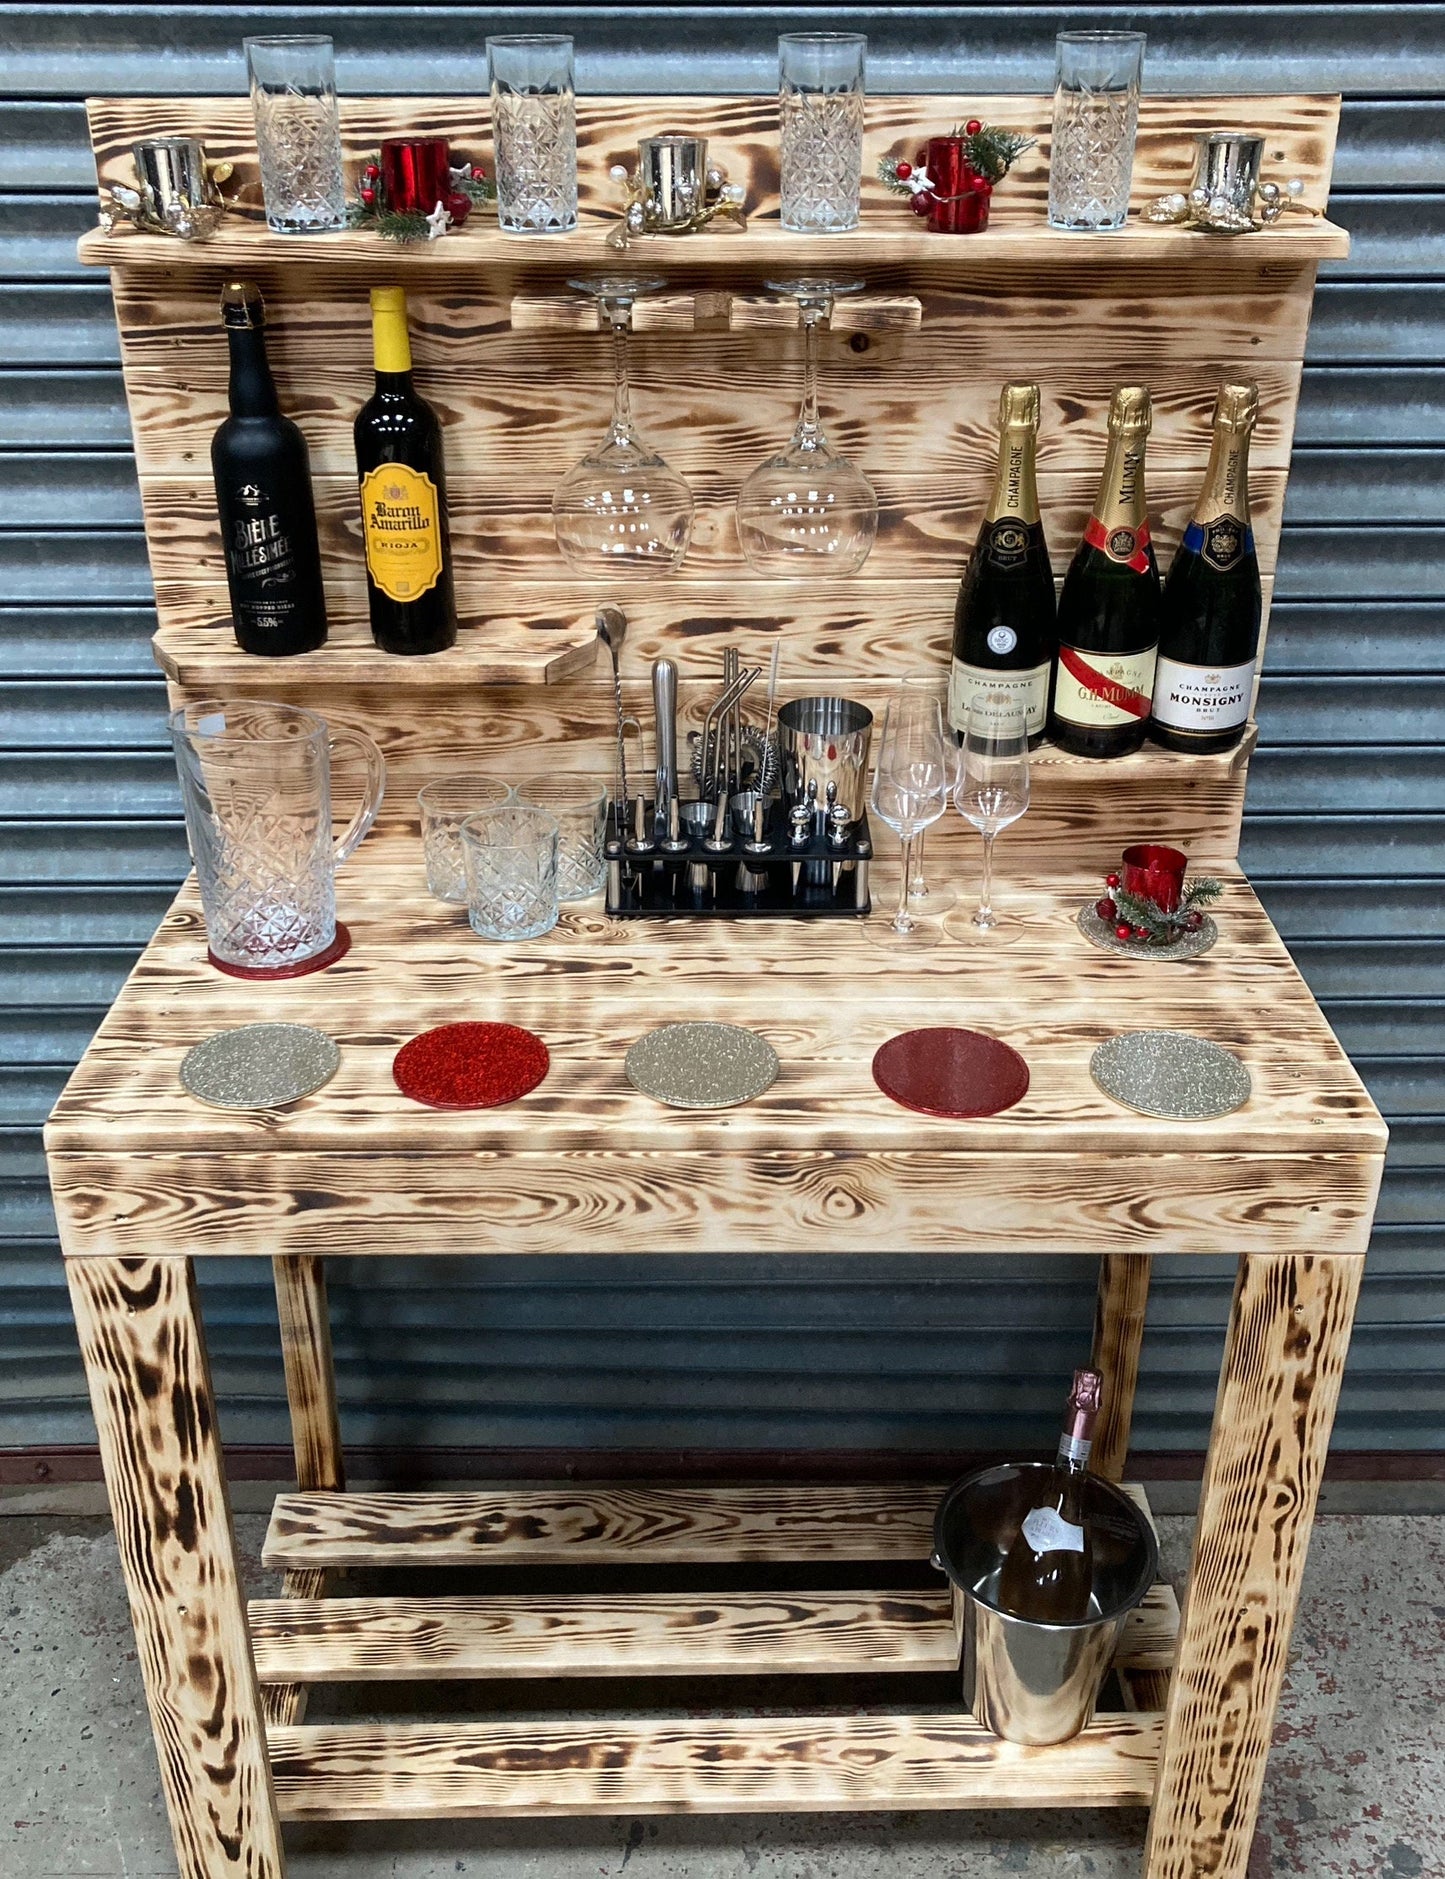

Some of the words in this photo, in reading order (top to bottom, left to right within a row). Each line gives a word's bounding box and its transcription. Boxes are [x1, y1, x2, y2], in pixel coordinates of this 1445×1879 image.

[1007, 445, 1024, 508] CHAMPAGNE
[1119, 452, 1141, 505] MUMM
[1224, 450, 1241, 505] CHAMPAGNE
[375, 501, 421, 518] Baron
[370, 513, 430, 531] Amarillo
[968, 678, 1033, 689] CHAMPAGNE
[1178, 683, 1241, 693] CHAMPAGNE
[1170, 692, 1244, 707] MONSIGNY
